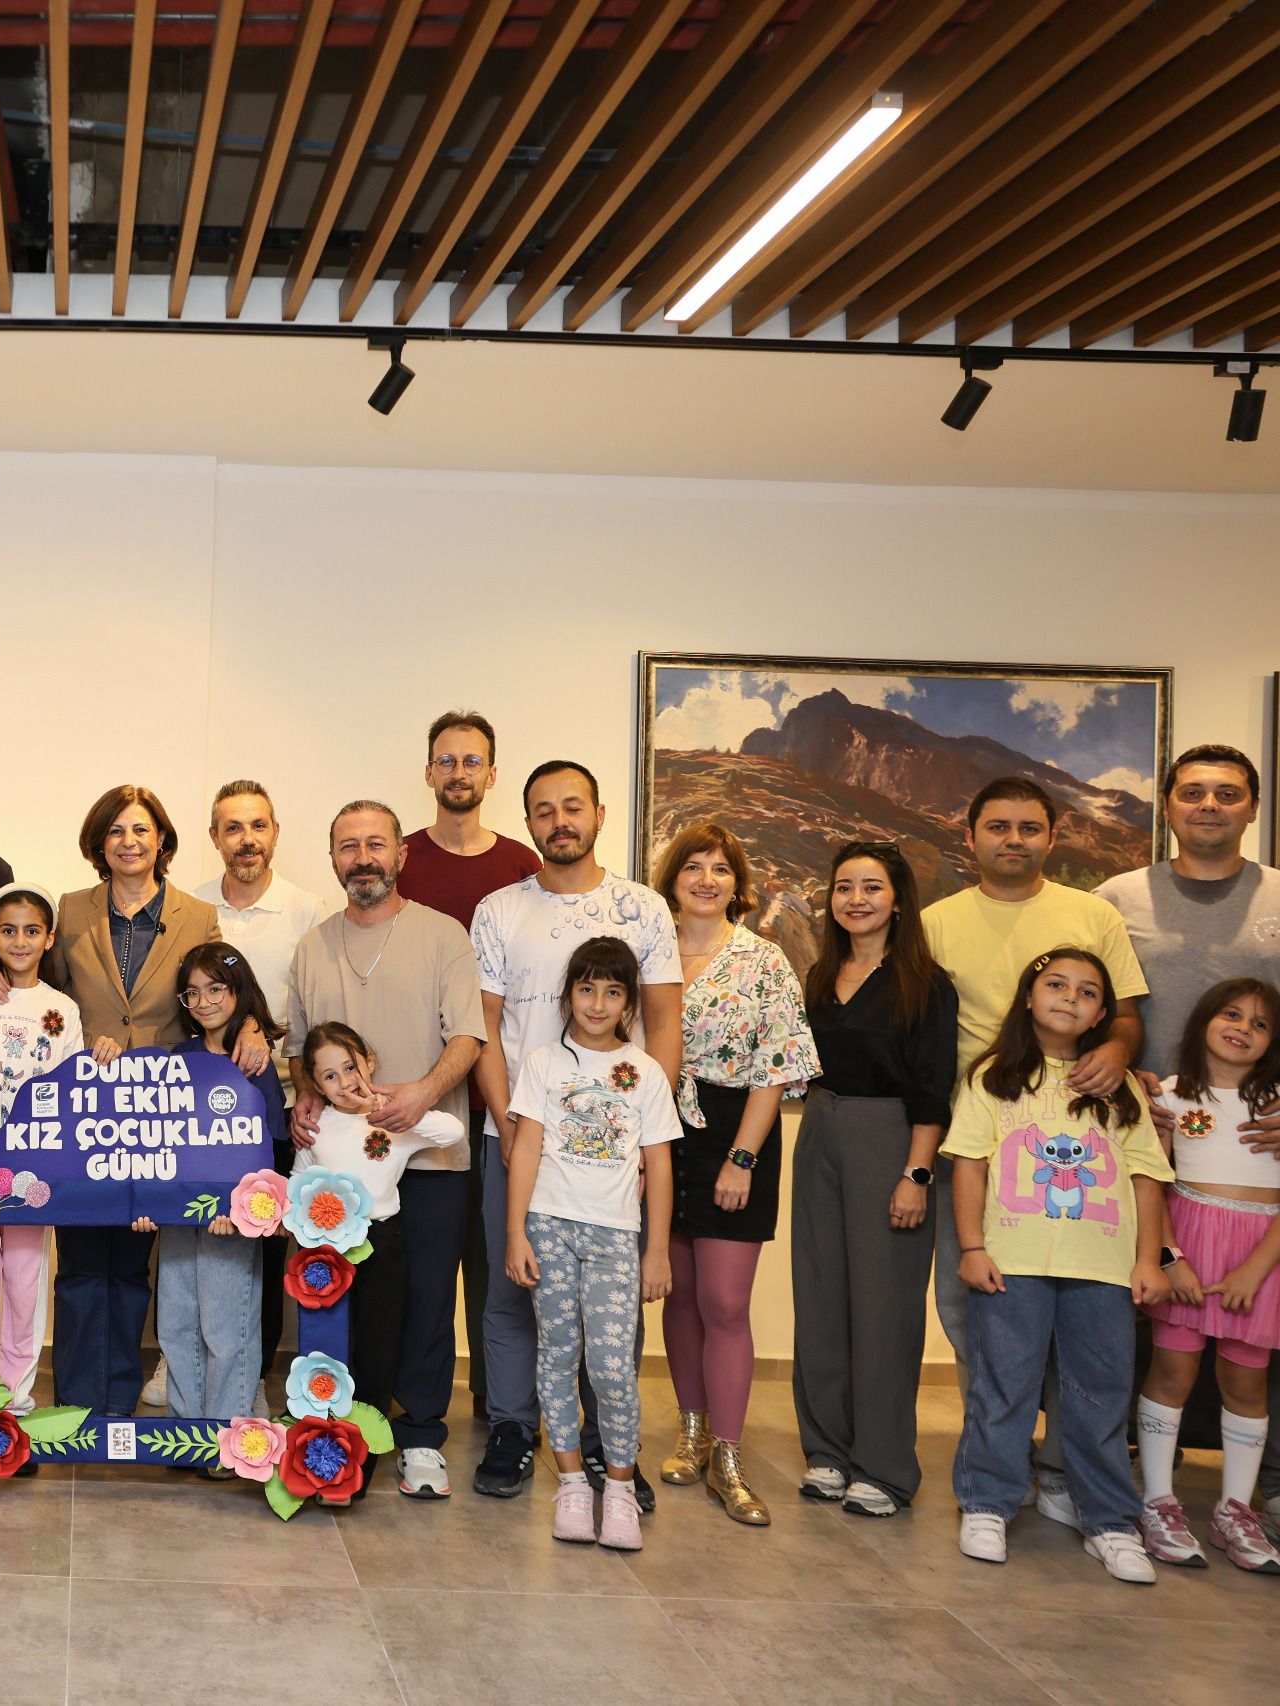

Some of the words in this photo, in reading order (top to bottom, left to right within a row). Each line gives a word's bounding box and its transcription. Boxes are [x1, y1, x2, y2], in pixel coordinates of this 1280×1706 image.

[69, 1086, 98, 1114] 11
[113, 1080, 195, 1114] EKİM
[5, 1121, 63, 1151] KIZ
[75, 1116, 263, 1151] ÇOCUKLARI
[86, 1148, 177, 1181] GÜNÜ
